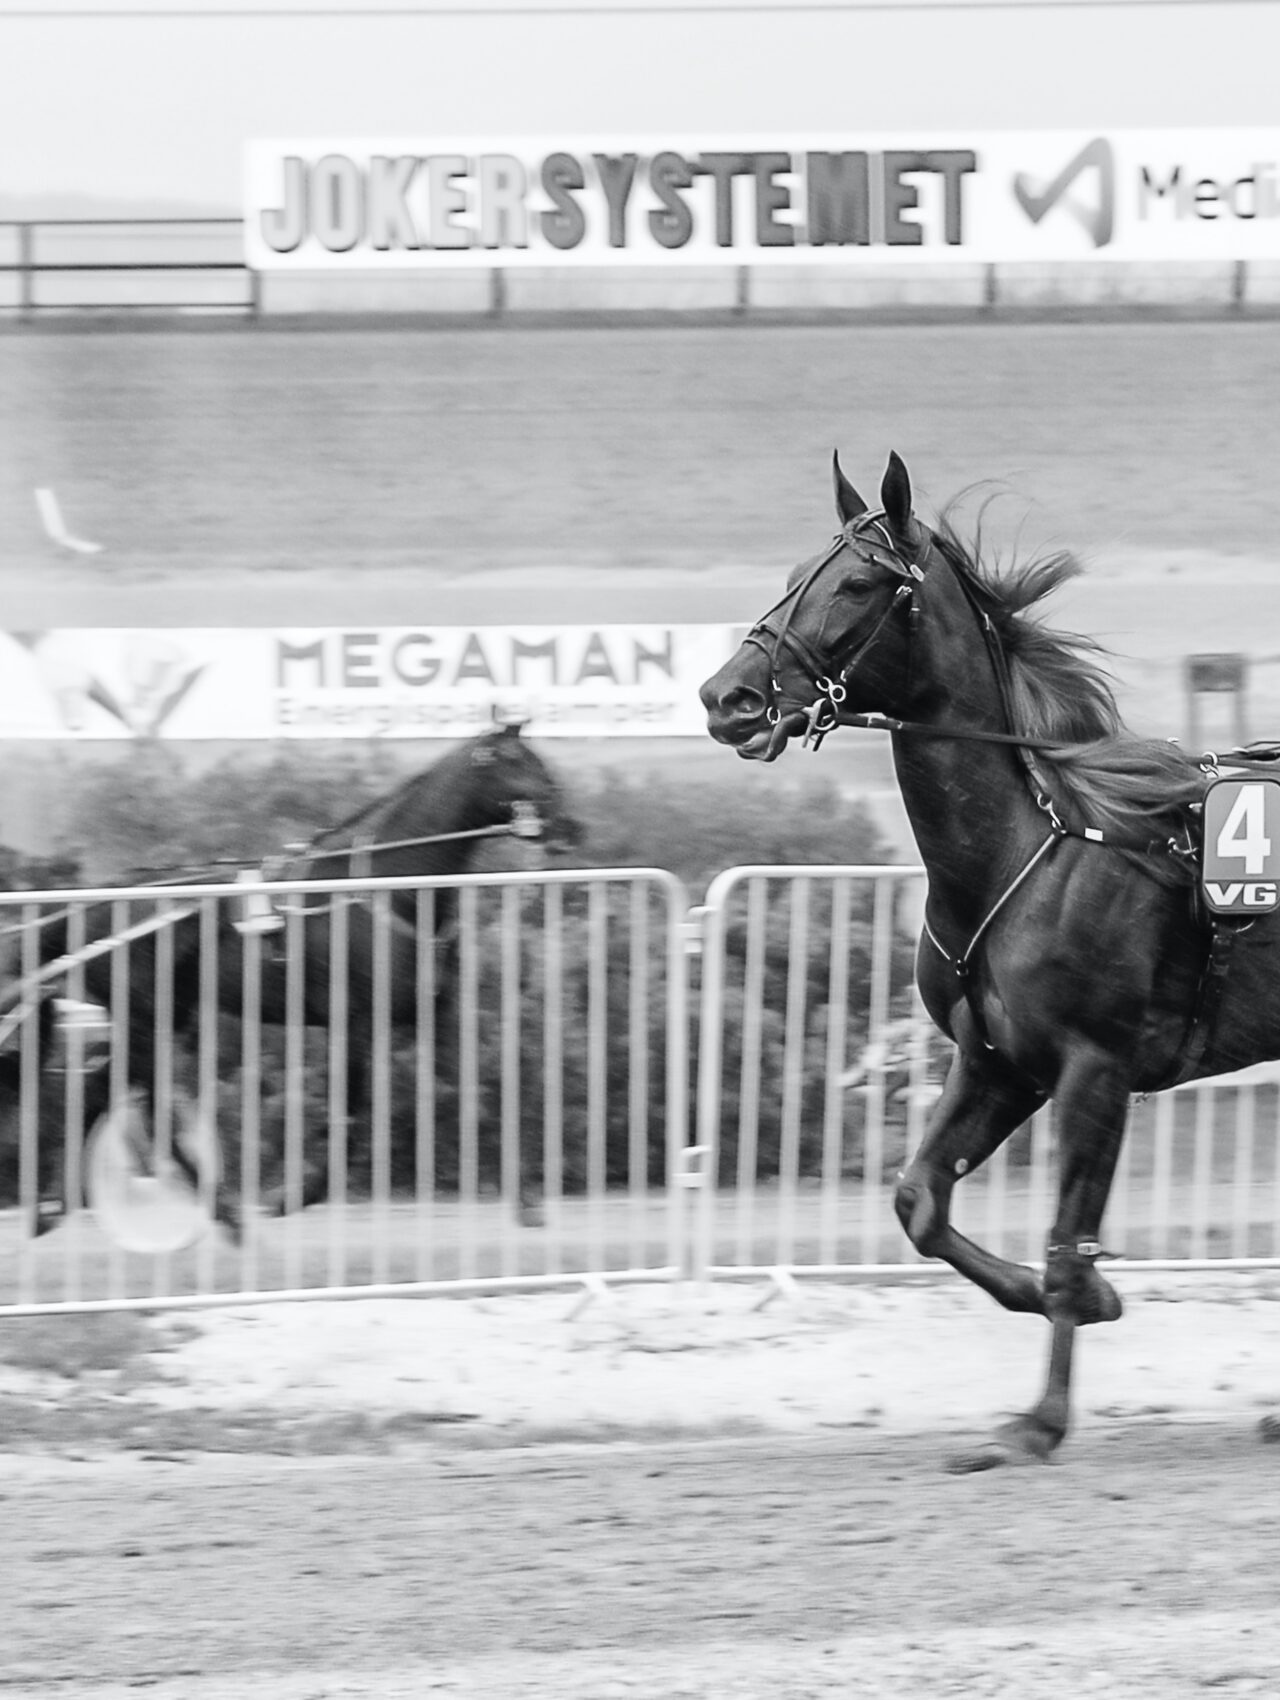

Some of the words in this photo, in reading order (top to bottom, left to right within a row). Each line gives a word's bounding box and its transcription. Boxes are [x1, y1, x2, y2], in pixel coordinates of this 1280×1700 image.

[260, 150, 977, 252] JOKERSYSTEMET
[275, 630, 676, 688] MEGAMAN
[1216, 784, 1271, 874] 4
[1204, 883, 1277, 906] VG
